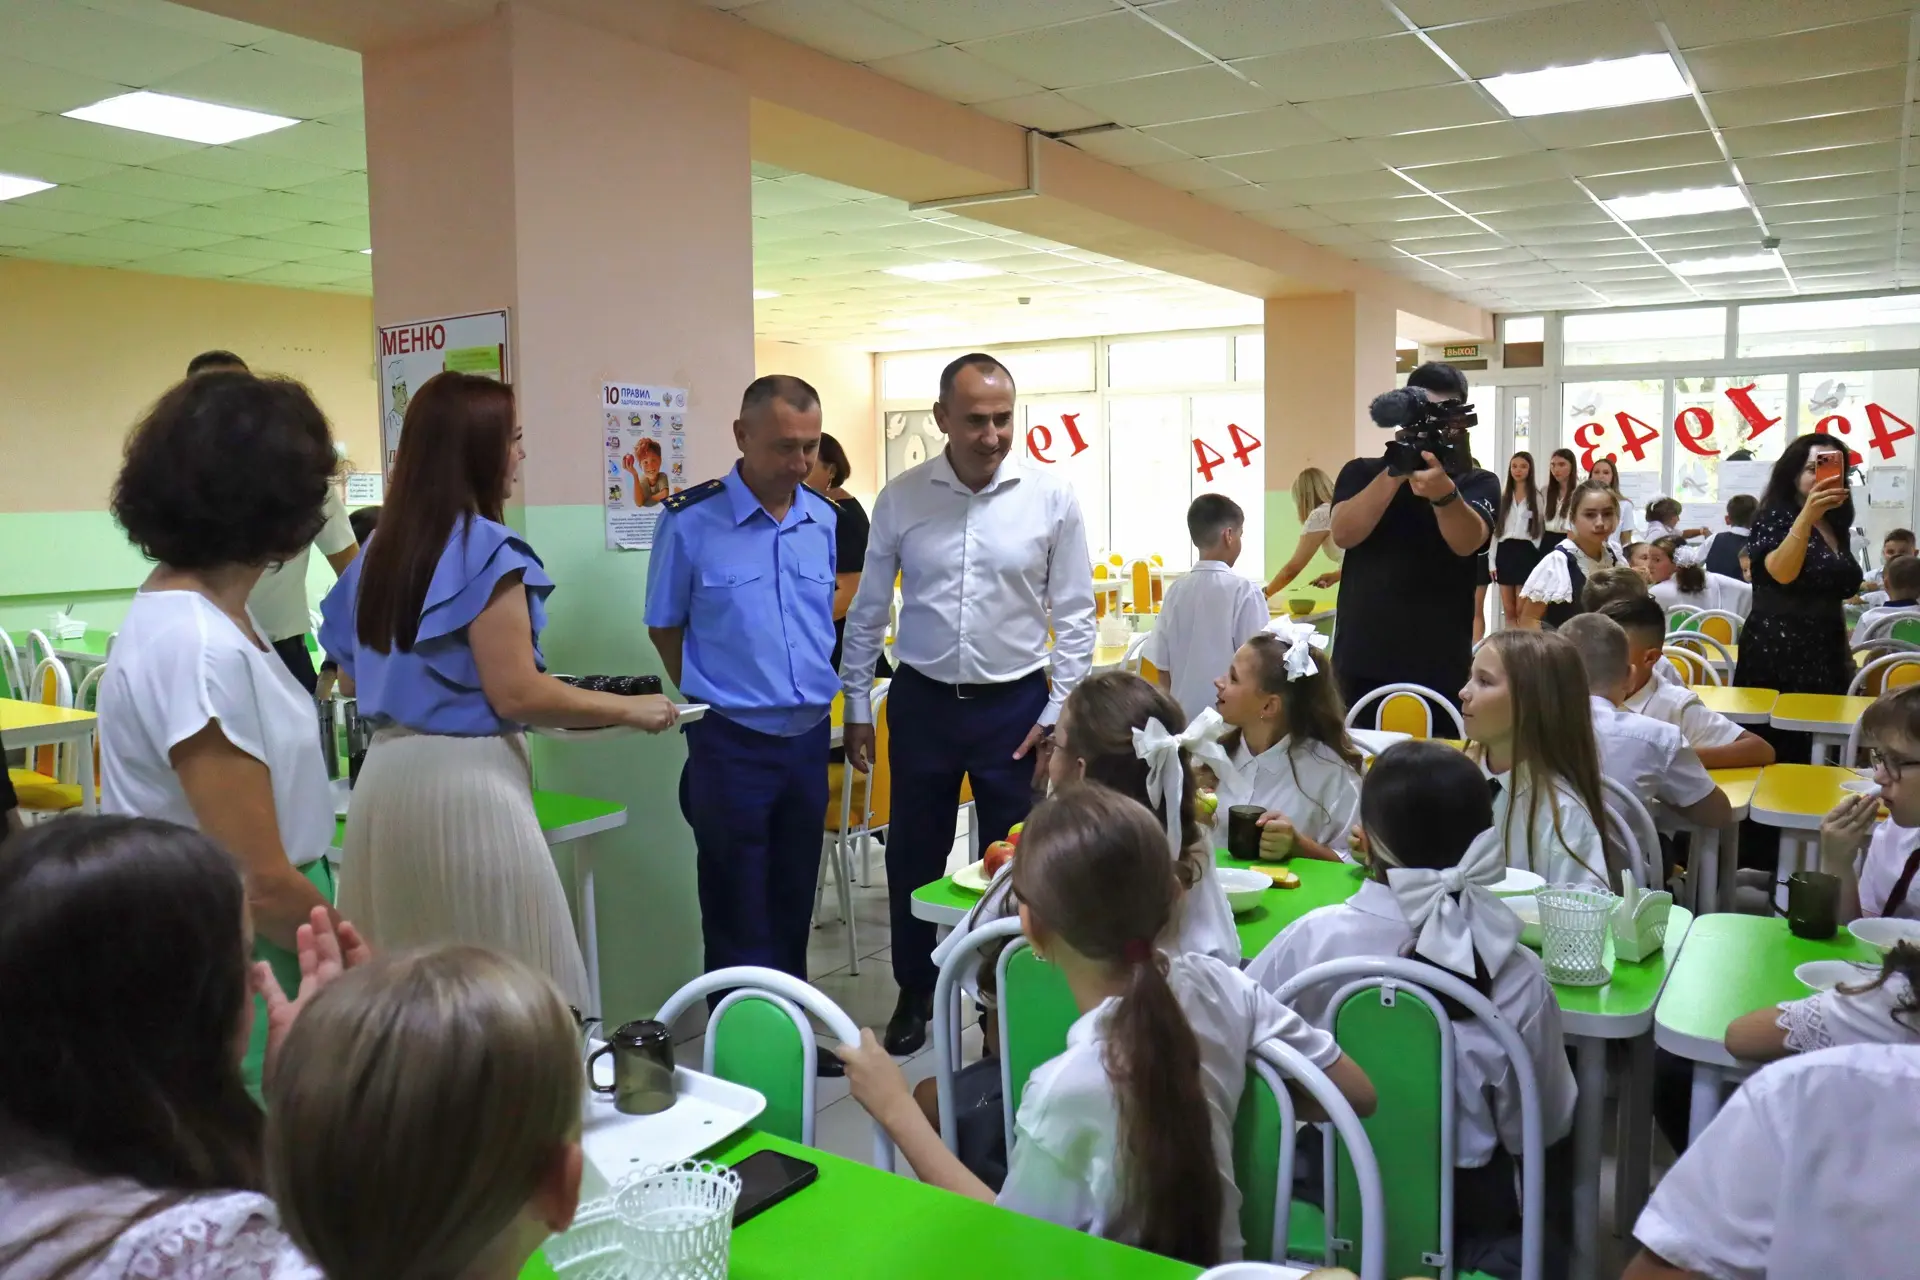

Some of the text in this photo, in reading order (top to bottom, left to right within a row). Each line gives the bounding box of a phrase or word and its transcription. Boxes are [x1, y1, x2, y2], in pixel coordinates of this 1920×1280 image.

[382, 324, 446, 356] МЕНЮ
[1446, 347, 1476, 356] ВЫХОД
[604, 386, 650, 405] 10 ПРАВИЛ
